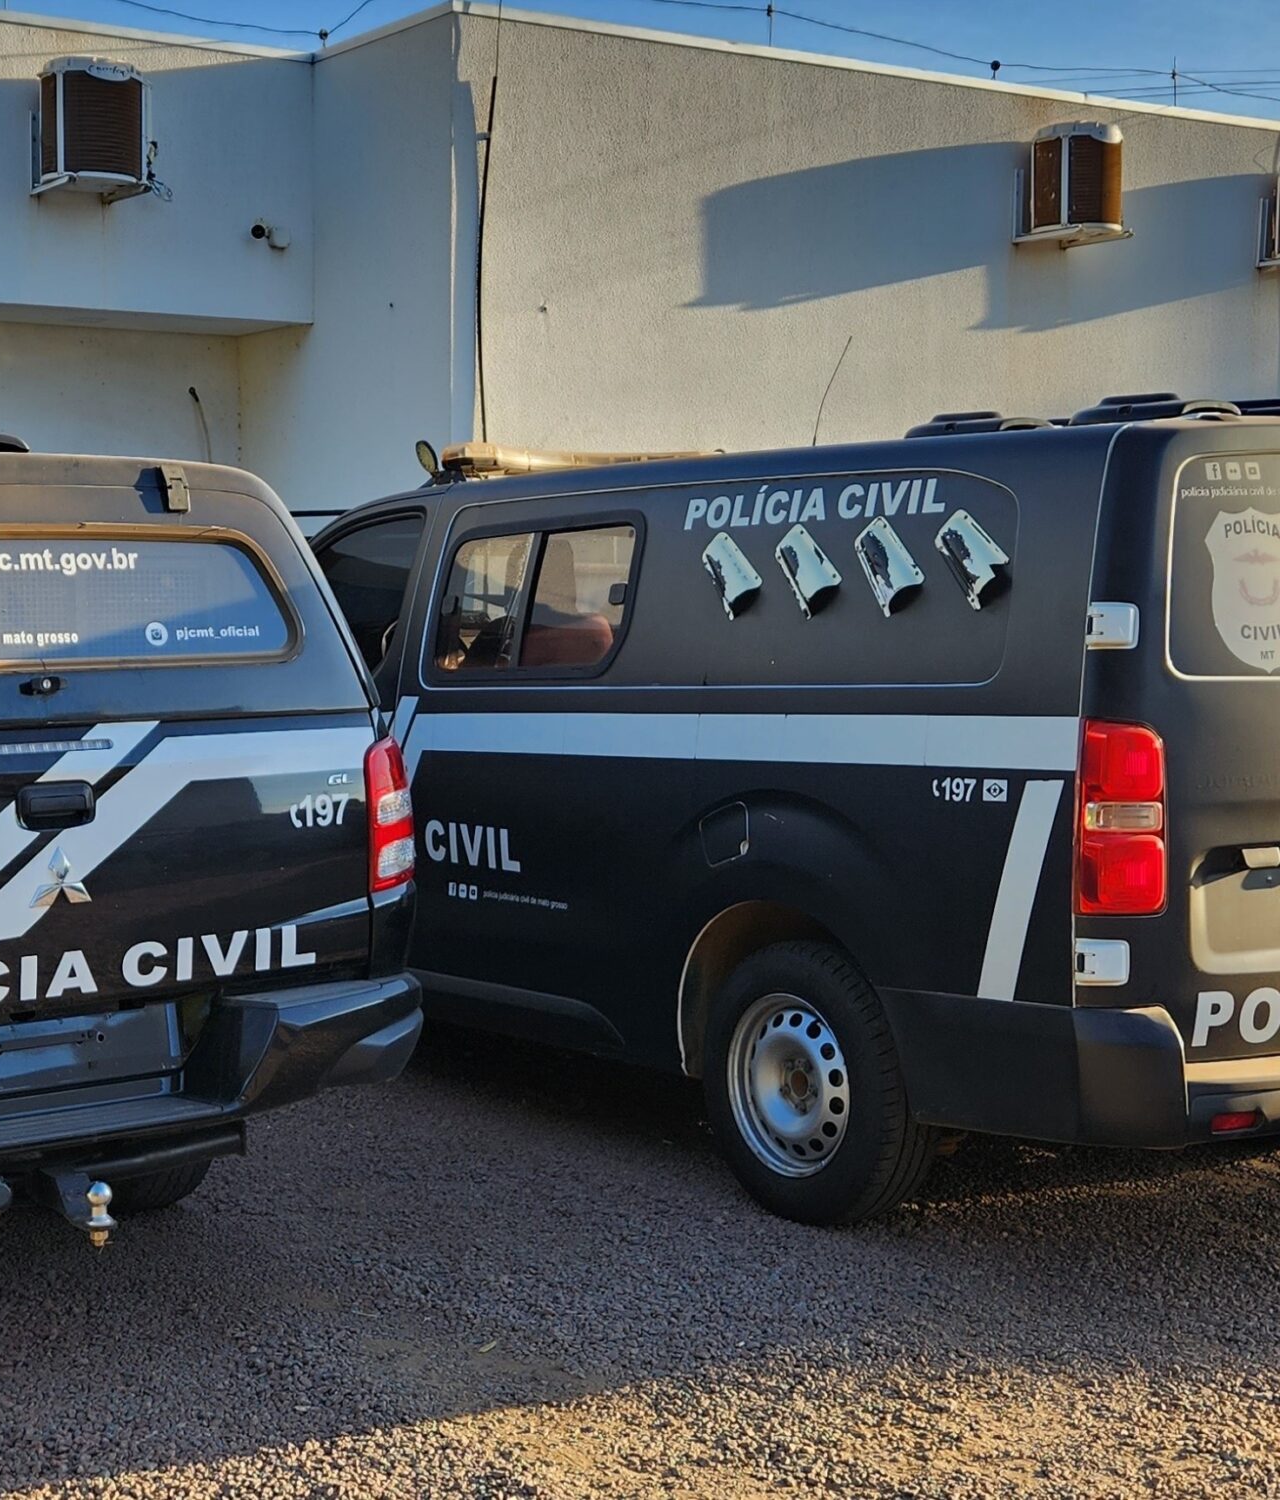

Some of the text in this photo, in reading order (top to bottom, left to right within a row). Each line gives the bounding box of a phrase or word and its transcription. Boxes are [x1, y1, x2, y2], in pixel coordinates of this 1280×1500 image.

[683, 478, 946, 530] POLÍCIA CIVIL
[2, 631, 34, 645] mato
[36, 632, 79, 647] grosso
[176, 625, 260, 641] pjcmt_oficial
[1260, 650, 1275, 660] MT
[328, 773, 353, 785] GL
[941, 777, 977, 802] 197
[299, 793, 349, 827] 197
[425, 819, 521, 872] CIVIL
[122, 924, 316, 987] CIVIL
